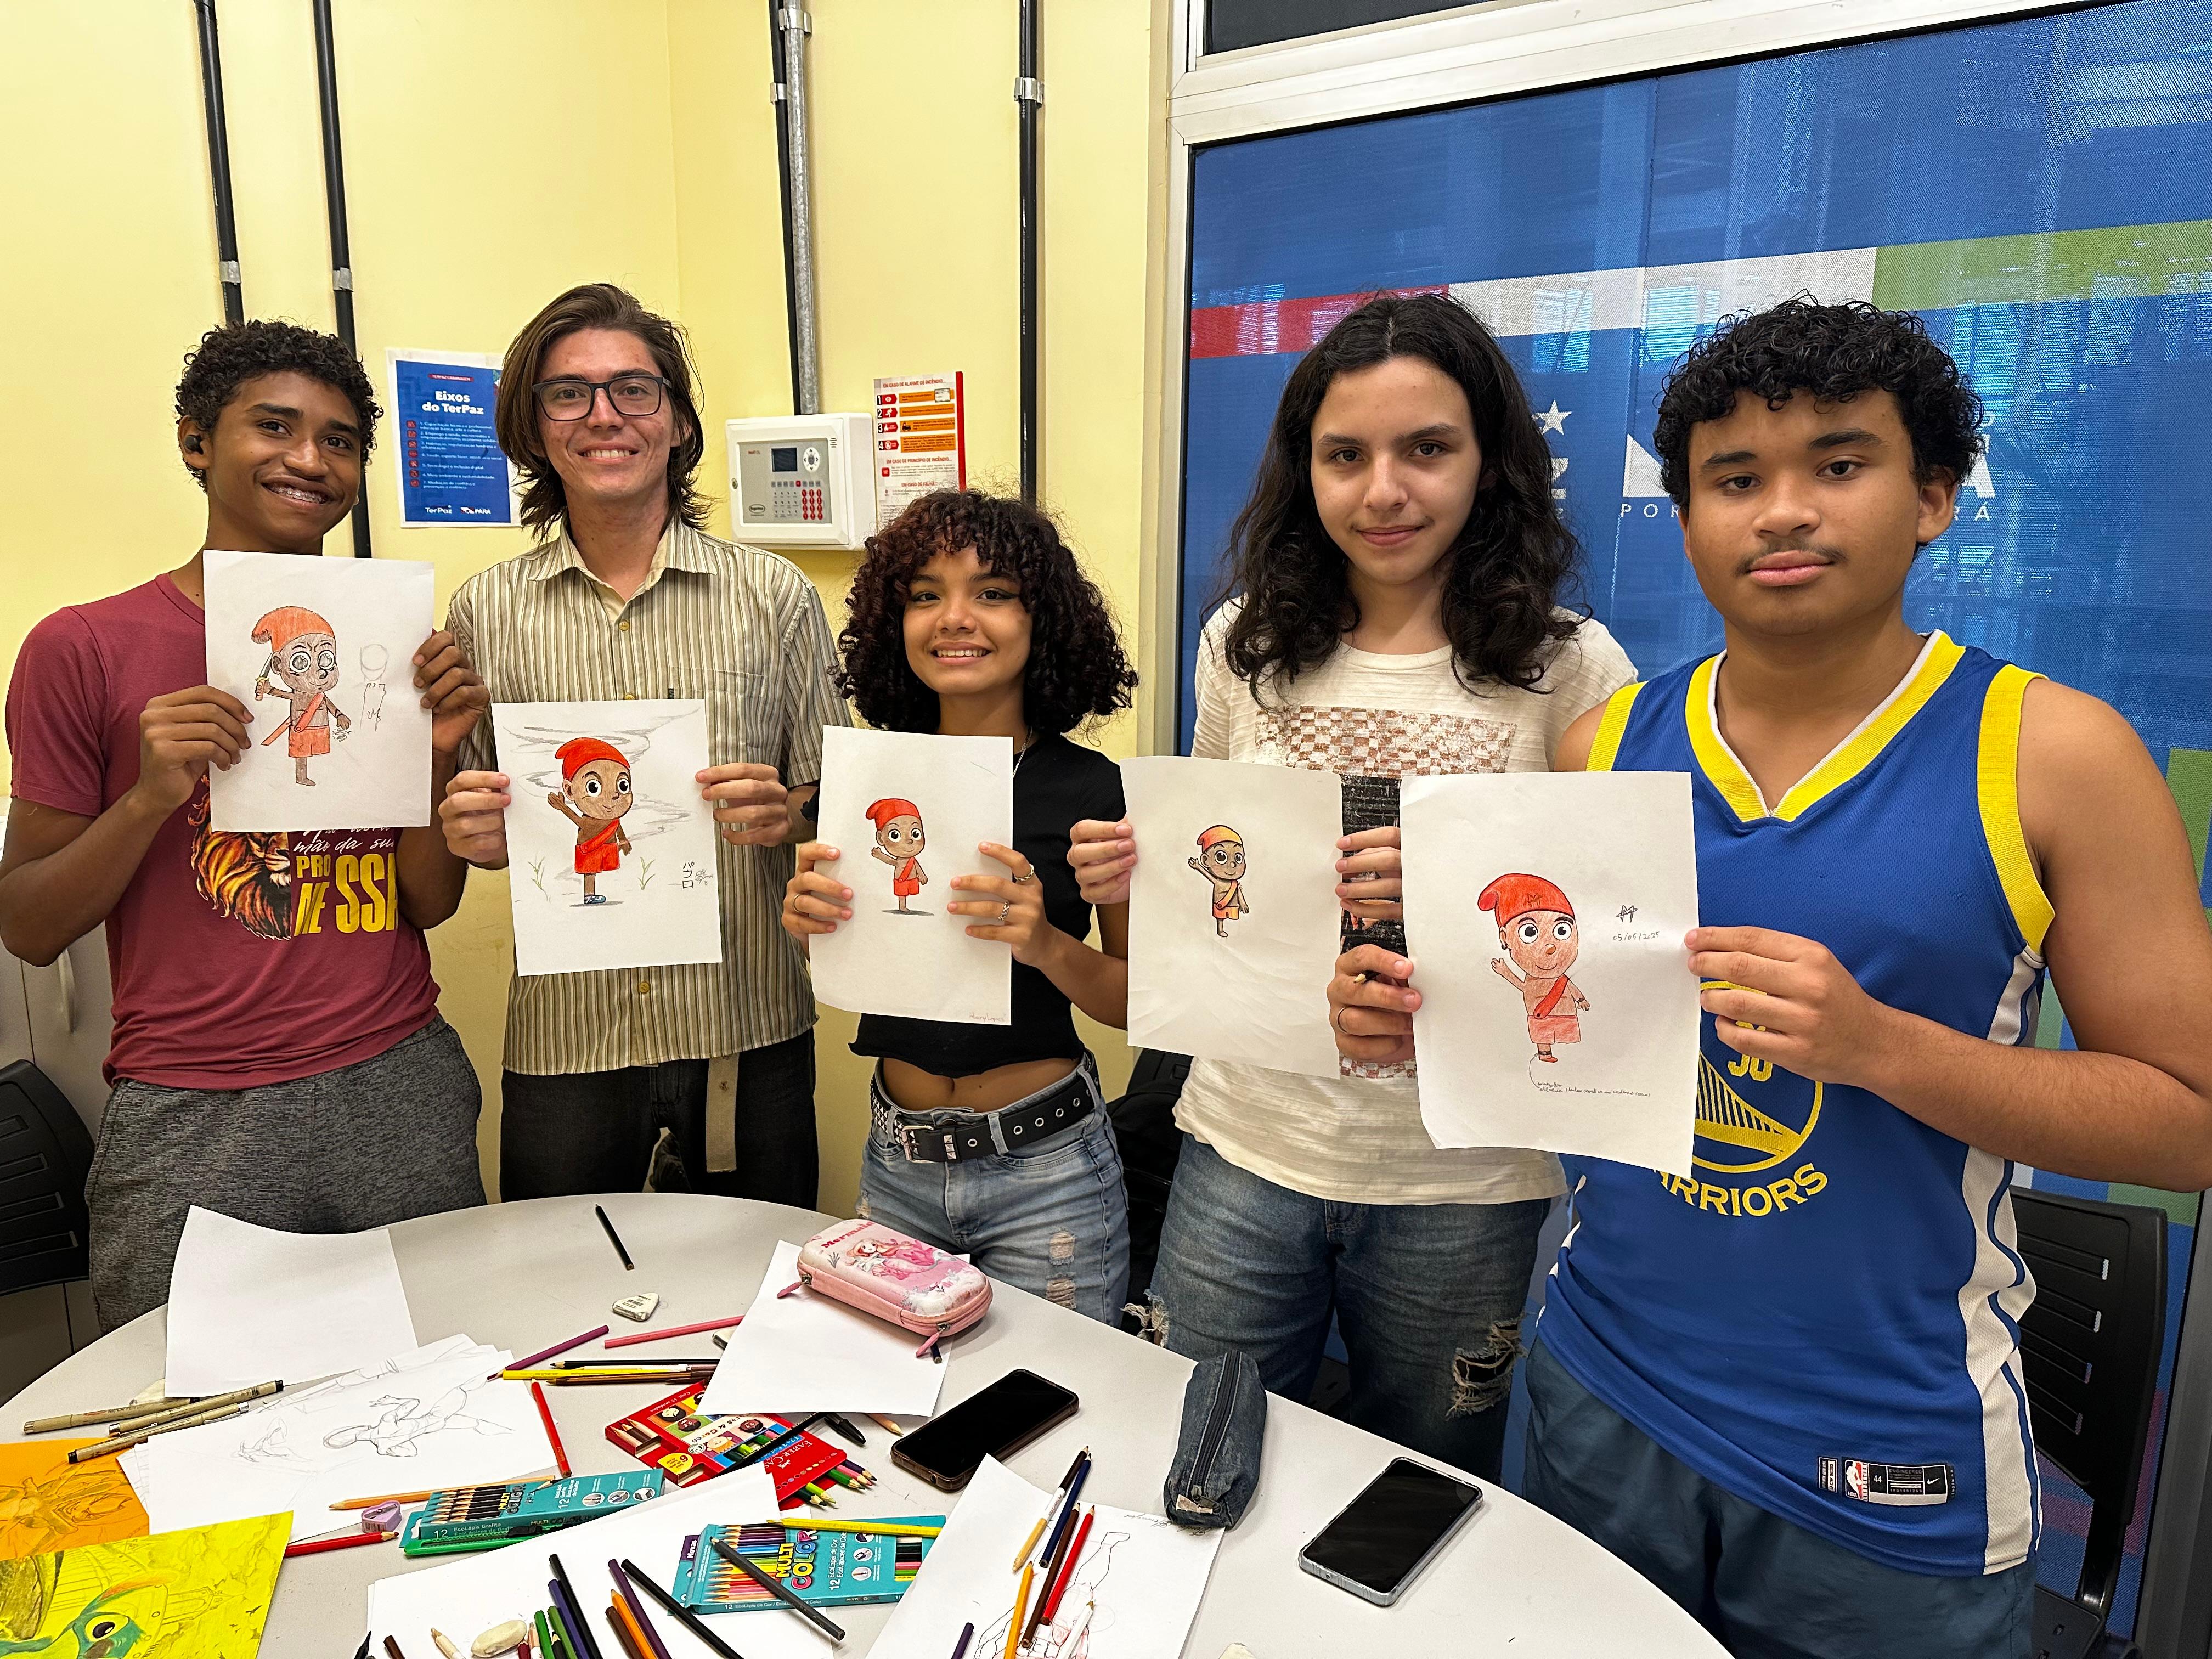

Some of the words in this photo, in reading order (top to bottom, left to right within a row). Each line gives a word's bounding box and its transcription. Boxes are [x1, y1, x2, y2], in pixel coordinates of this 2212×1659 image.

[435, 391, 470, 403] Eixos
[422, 402, 440, 411] do
[441, 403, 484, 414] TerPaz
[878, 409, 882, 418] 2
[878, 423, 883, 433] 3
[878, 441, 883, 450] 4
[425, 505, 452, 514] TerPaz
[335, 837, 363, 854] da
[682, 861, 694, 889] パウロ
[1654, 1163, 1828, 1217] RRIORS
[821, 1221, 875, 1248] Mermaid
[679, 1455, 689, 1463] 6
[764, 1440, 813, 1468] FABER-CAS
[1874, 1475, 1882, 1483] 44
[498, 1492, 510, 1510] MULTI
[558, 1498, 569, 1509] 12
[434, 1529, 449, 1538] 12
[687, 1539, 697, 1559] Novas
[776, 1543, 795, 1578] MULTI
[791, 1529, 817, 1590] COLOR
[829, 1579, 841, 1591] 12
